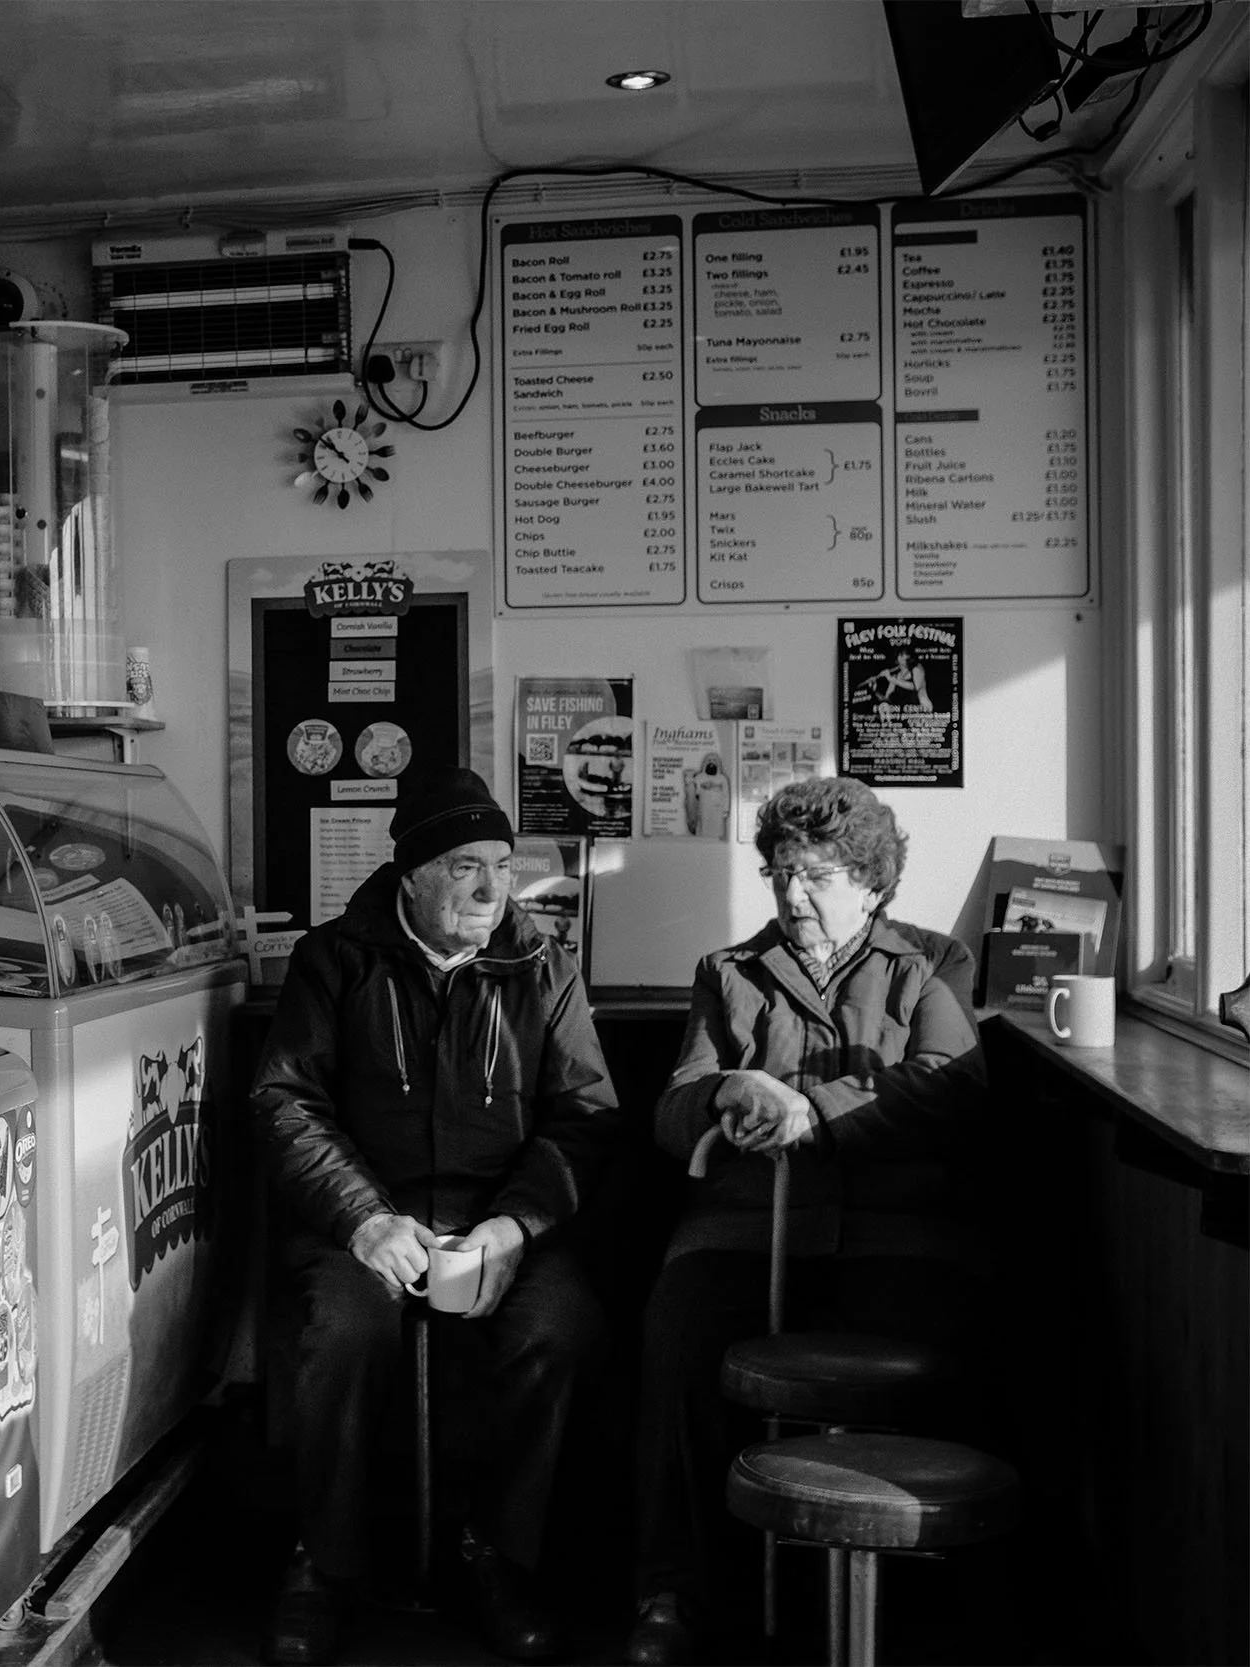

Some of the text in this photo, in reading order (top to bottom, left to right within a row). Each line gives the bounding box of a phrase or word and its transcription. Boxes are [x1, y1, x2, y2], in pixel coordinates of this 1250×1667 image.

[718, 213, 754, 228] Cold
[529, 220, 652, 239] Hot Sandwiches
[643, 251, 673, 261] £2.75
[705, 252, 763, 263] One filling
[840, 247, 870, 258] £1.95
[512, 256, 570, 268] Bacon Roll
[902, 253, 922, 263] Tea
[643, 267, 673, 278] £3.25
[706, 269, 769, 280] Two fillings
[837, 264, 869, 275] £2.45
[902, 266, 941, 276] Coffee
[512, 270, 622, 284] Bacon & Tomato roll
[512, 288, 606, 301] Bacon & Egg Roll
[643, 284, 673, 295] £3.25
[512, 303, 641, 318] Bacon & Mushroom Roll
[643, 301, 673, 312] £3.25
[903, 307, 941, 316] Mocha
[512, 322, 590, 334] Fried Egg Roll
[643, 318, 673, 328] £2.25
[903, 318, 986, 328] Hot Chocolate
[707, 336, 801, 347] Tuna Mayonnaise
[840, 331, 870, 342] £2.75
[904, 359, 951, 368] Horlicks
[513, 375, 594, 386] Toasted Cheese
[642, 371, 673, 381] £2.50
[904, 374, 934, 384] Soup
[513, 389, 563, 399] Sandwich
[904, 387, 938, 398] Bovril
[759, 406, 816, 421] Snacks
[514, 431, 574, 440] Beefburger
[645, 426, 674, 436] £2.75
[905, 435, 933, 445] Cans
[514, 447, 592, 457] Double Burger
[643, 443, 674, 453] £3.60
[709, 442, 762, 453] Flap Jack
[1047, 443, 1076, 454] £1.75
[905, 449, 946, 458] Bottles
[643, 460, 674, 470] £3.00
[710, 456, 775, 466] Eccles Cake
[905, 460, 966, 471] Fruit Juice
[514, 464, 590, 474] Cheeseburger
[709, 468, 815, 480] Caramel Shortcake
[642, 477, 675, 487] £4.00
[905, 473, 994, 484] Ribena Cartons
[514, 479, 633, 491] Double Cheeseburger
[710, 482, 819, 495] Large Bakewell Tart
[905, 488, 928, 497] Milk
[514, 497, 599, 508] Sausage Burger
[645, 494, 675, 504] £2.75
[906, 500, 986, 511] Mineral Water
[515, 515, 560, 525] Hot Dog
[648, 511, 675, 521] £1.95
[709, 512, 736, 521] Mars
[906, 514, 937, 524] Slush
[643, 528, 675, 538] £2.00
[710, 525, 735, 535] Twix
[515, 532, 545, 541] Chips
[710, 539, 756, 549] Snickers
[906, 541, 968, 550] Milkshakes
[515, 548, 576, 559] Chip Buttie
[647, 545, 676, 555] £2.75
[710, 552, 749, 562] Kit Kat
[515, 564, 604, 575] Toasted Teacake
[649, 561, 676, 572] £1.75
[914, 561, 957, 569] Strawberry
[710, 580, 745, 591] Crisps
[313, 582, 404, 605] KELLY'S
[337, 621, 393, 630] Cornish Vanilla
[845, 624, 956, 648] FILEY FOLK FESTIVAL
[342, 667, 382, 676] Strawberry
[373, 688, 390, 696] Chip
[527, 697, 603, 712] SAVE FISHING
[527, 715, 572, 729] IN FILEY
[653, 726, 713, 741] Inghams
